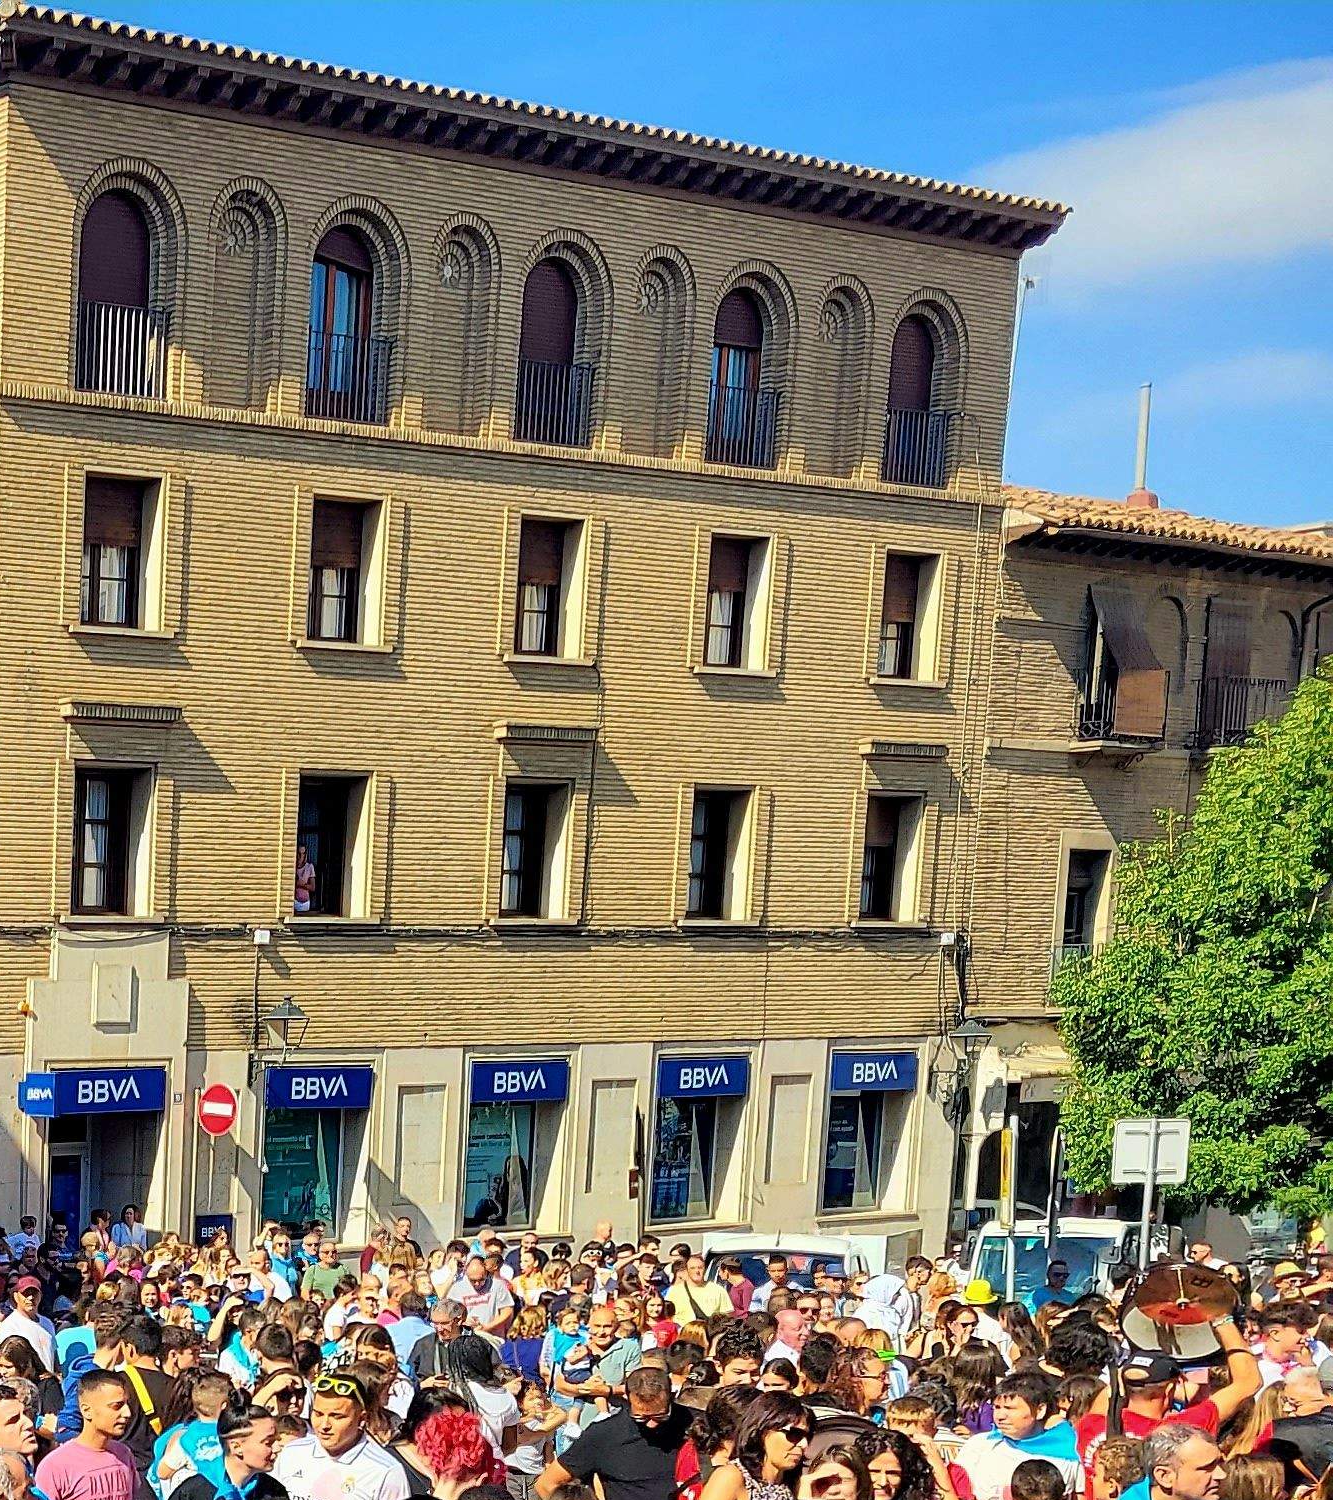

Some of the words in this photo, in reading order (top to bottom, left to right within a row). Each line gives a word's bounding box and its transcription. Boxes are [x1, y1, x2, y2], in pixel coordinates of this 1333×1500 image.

[494, 1068, 546, 1093] BBVA
[679, 1064, 728, 1089] BBVA
[853, 1060, 897, 1083] BBVA
[27, 1088, 52, 1100] BBVA
[78, 1076, 140, 1103] BBVA
[291, 1074, 348, 1099] BBVA
